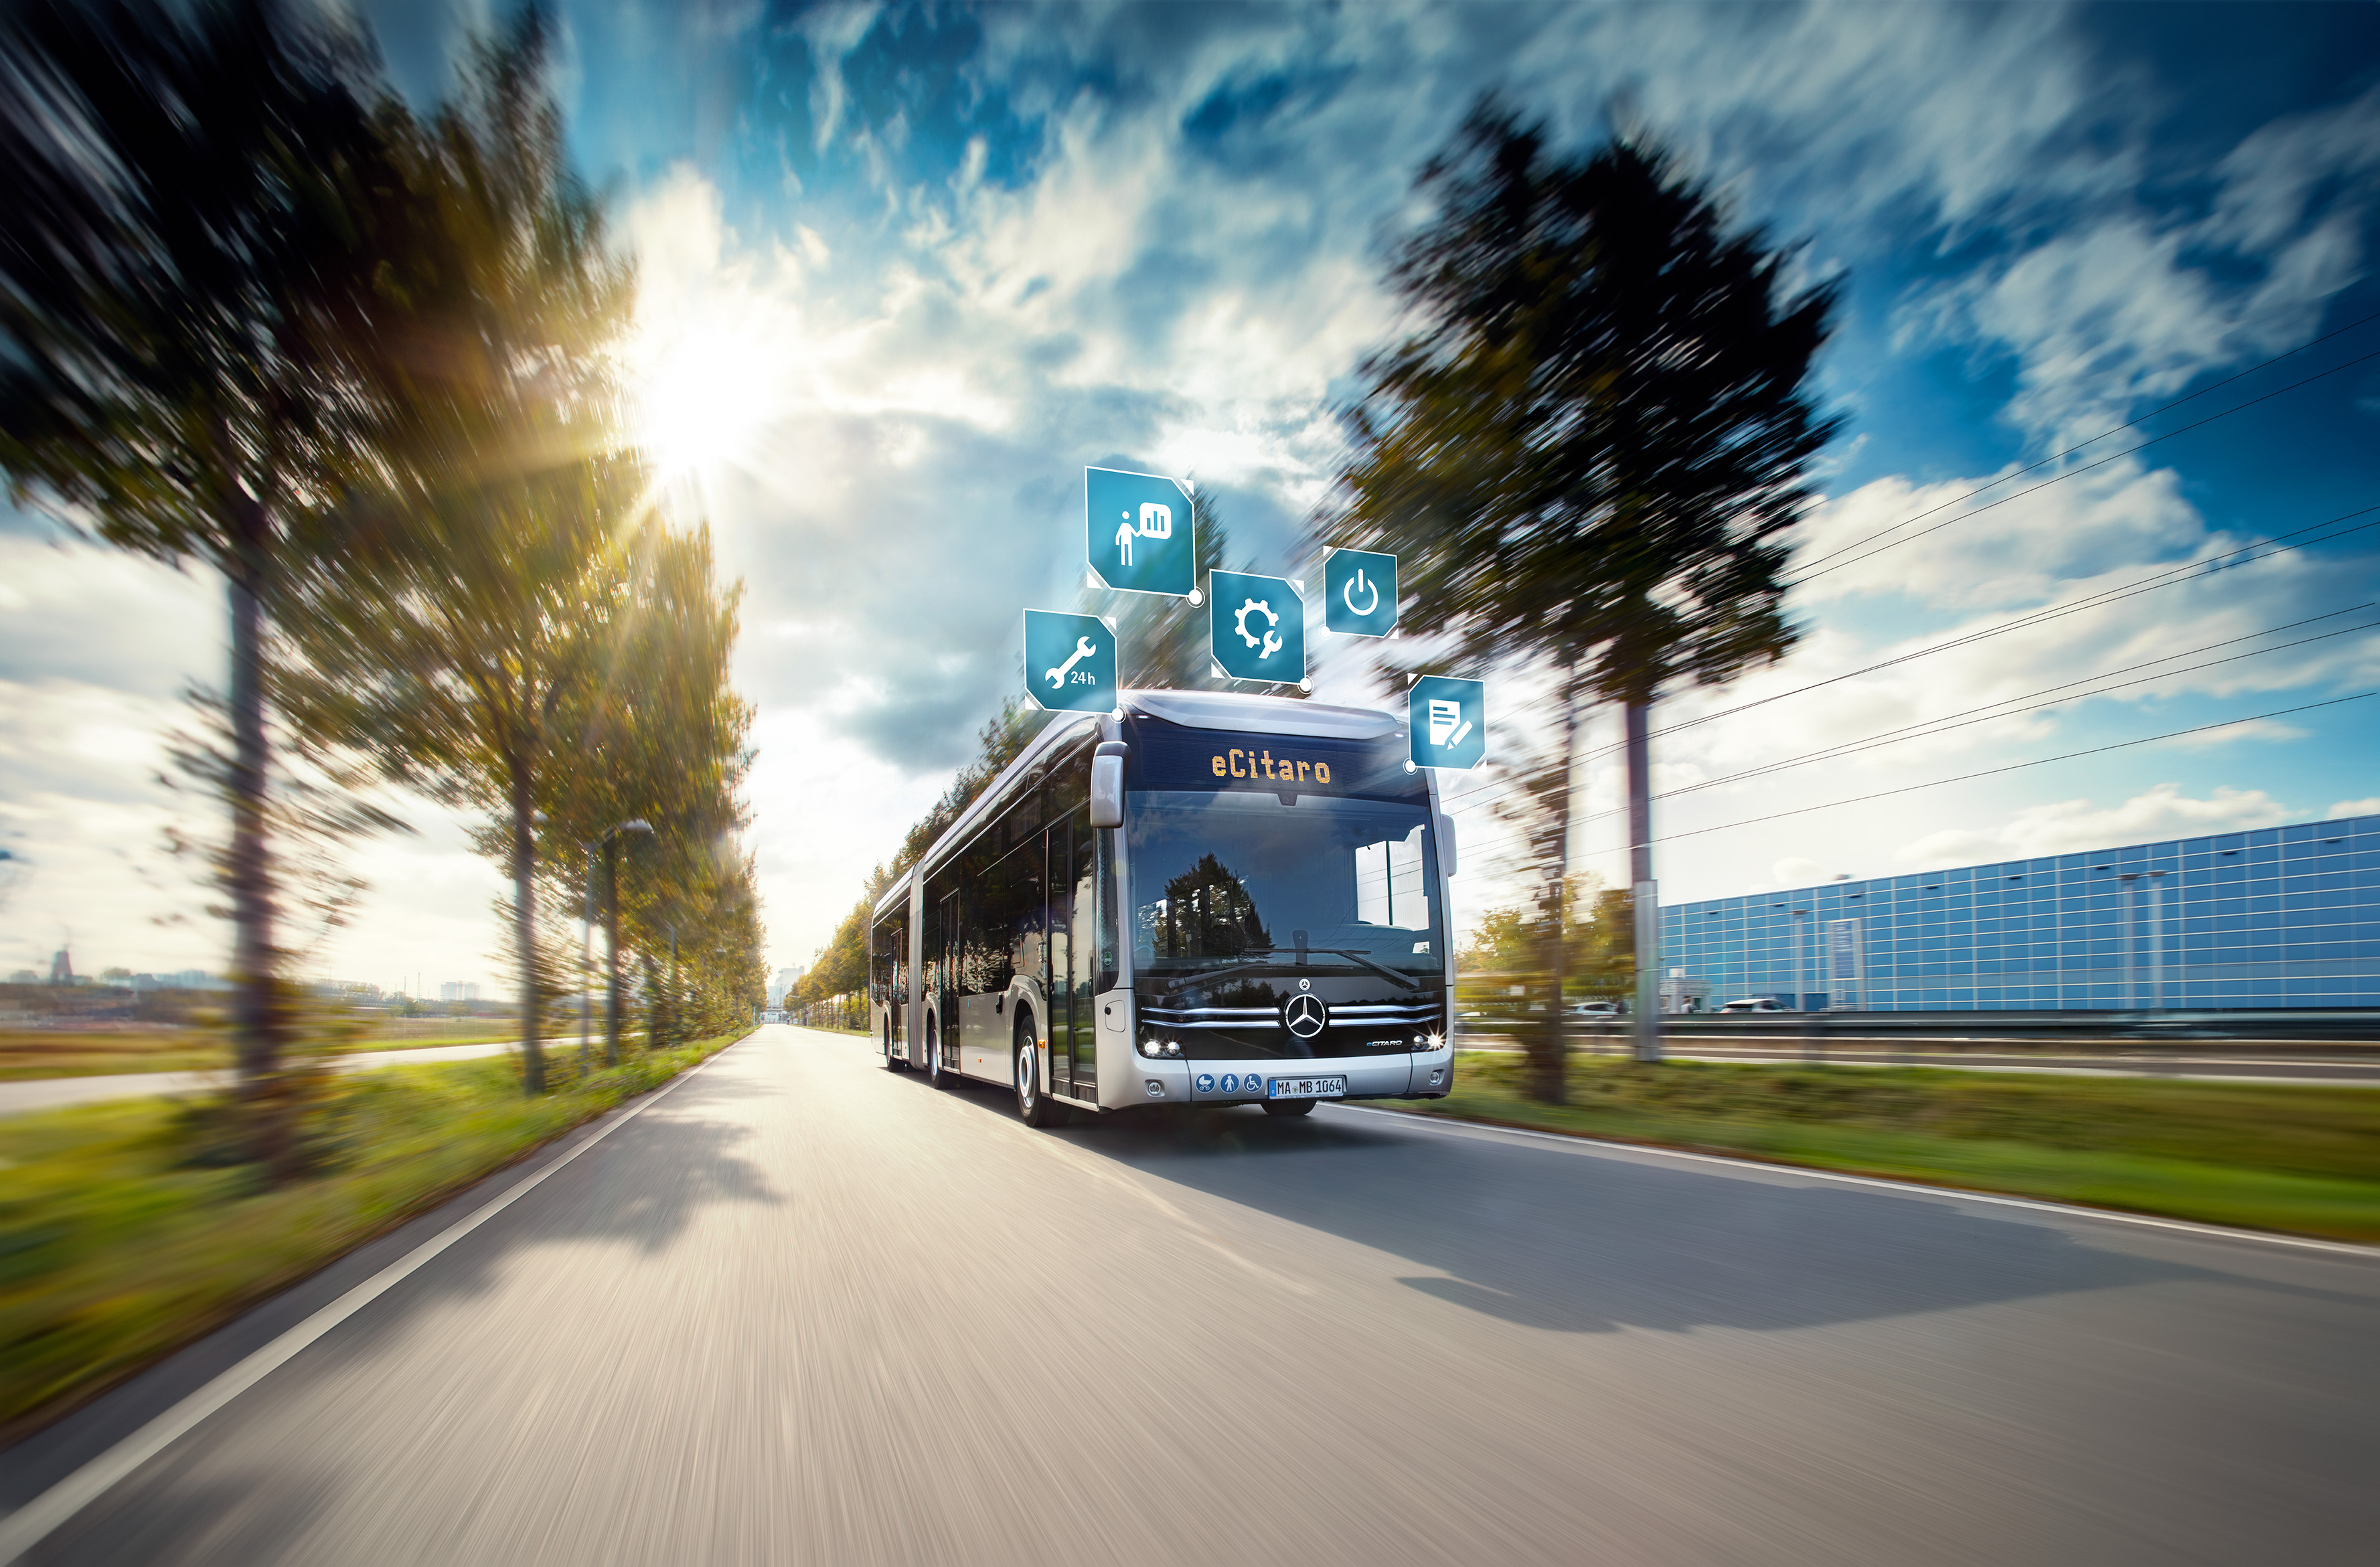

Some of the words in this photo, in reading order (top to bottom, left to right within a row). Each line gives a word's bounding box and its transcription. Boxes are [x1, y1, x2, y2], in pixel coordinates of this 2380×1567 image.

[1212, 748, 1331, 784] eCitaro
[1277, 1082, 1291, 1094] MA
[1299, 1081, 1312, 1094] MB
[1316, 1080, 1341, 1092] 1064
